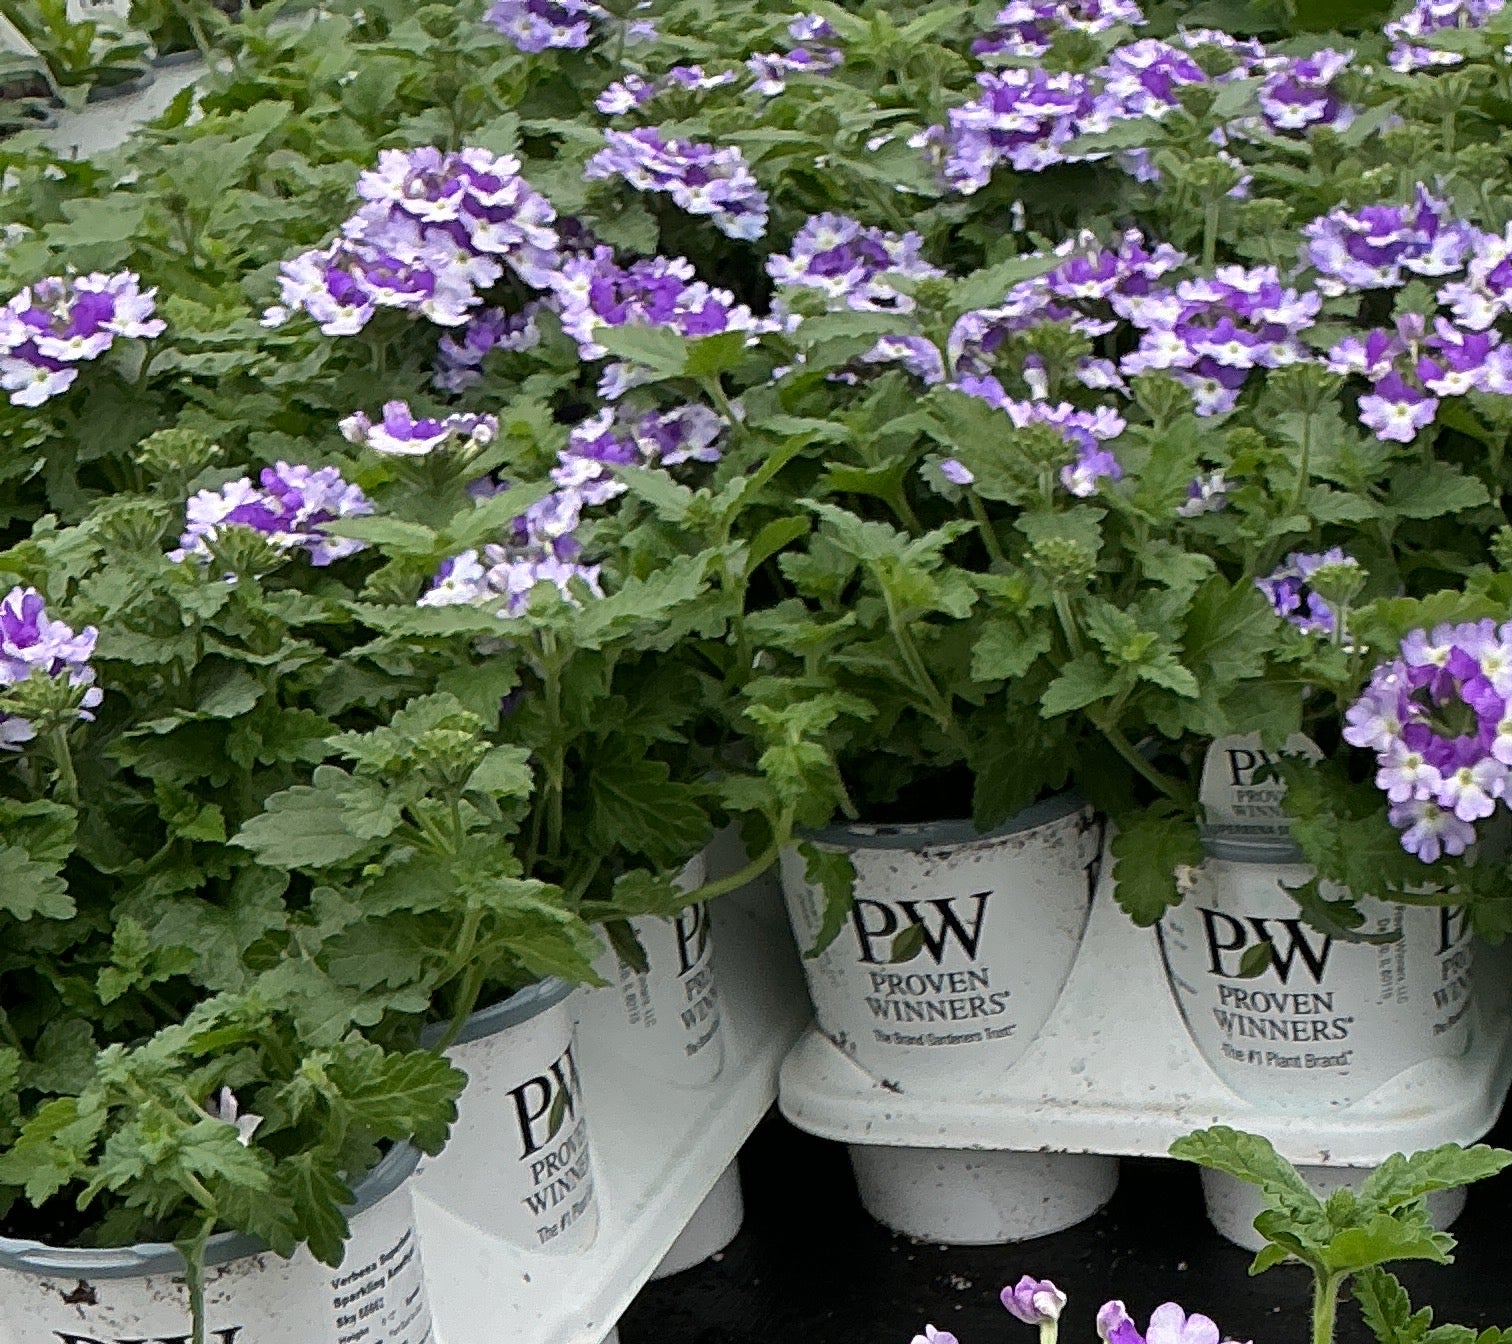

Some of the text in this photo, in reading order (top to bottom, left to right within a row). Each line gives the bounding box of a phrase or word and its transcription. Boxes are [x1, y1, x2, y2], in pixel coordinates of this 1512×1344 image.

[852, 890, 994, 965] PW
[1196, 906, 1332, 985] PW
[869, 968, 989, 996] PROVEN
[1217, 984, 1335, 1014] PROVEN
